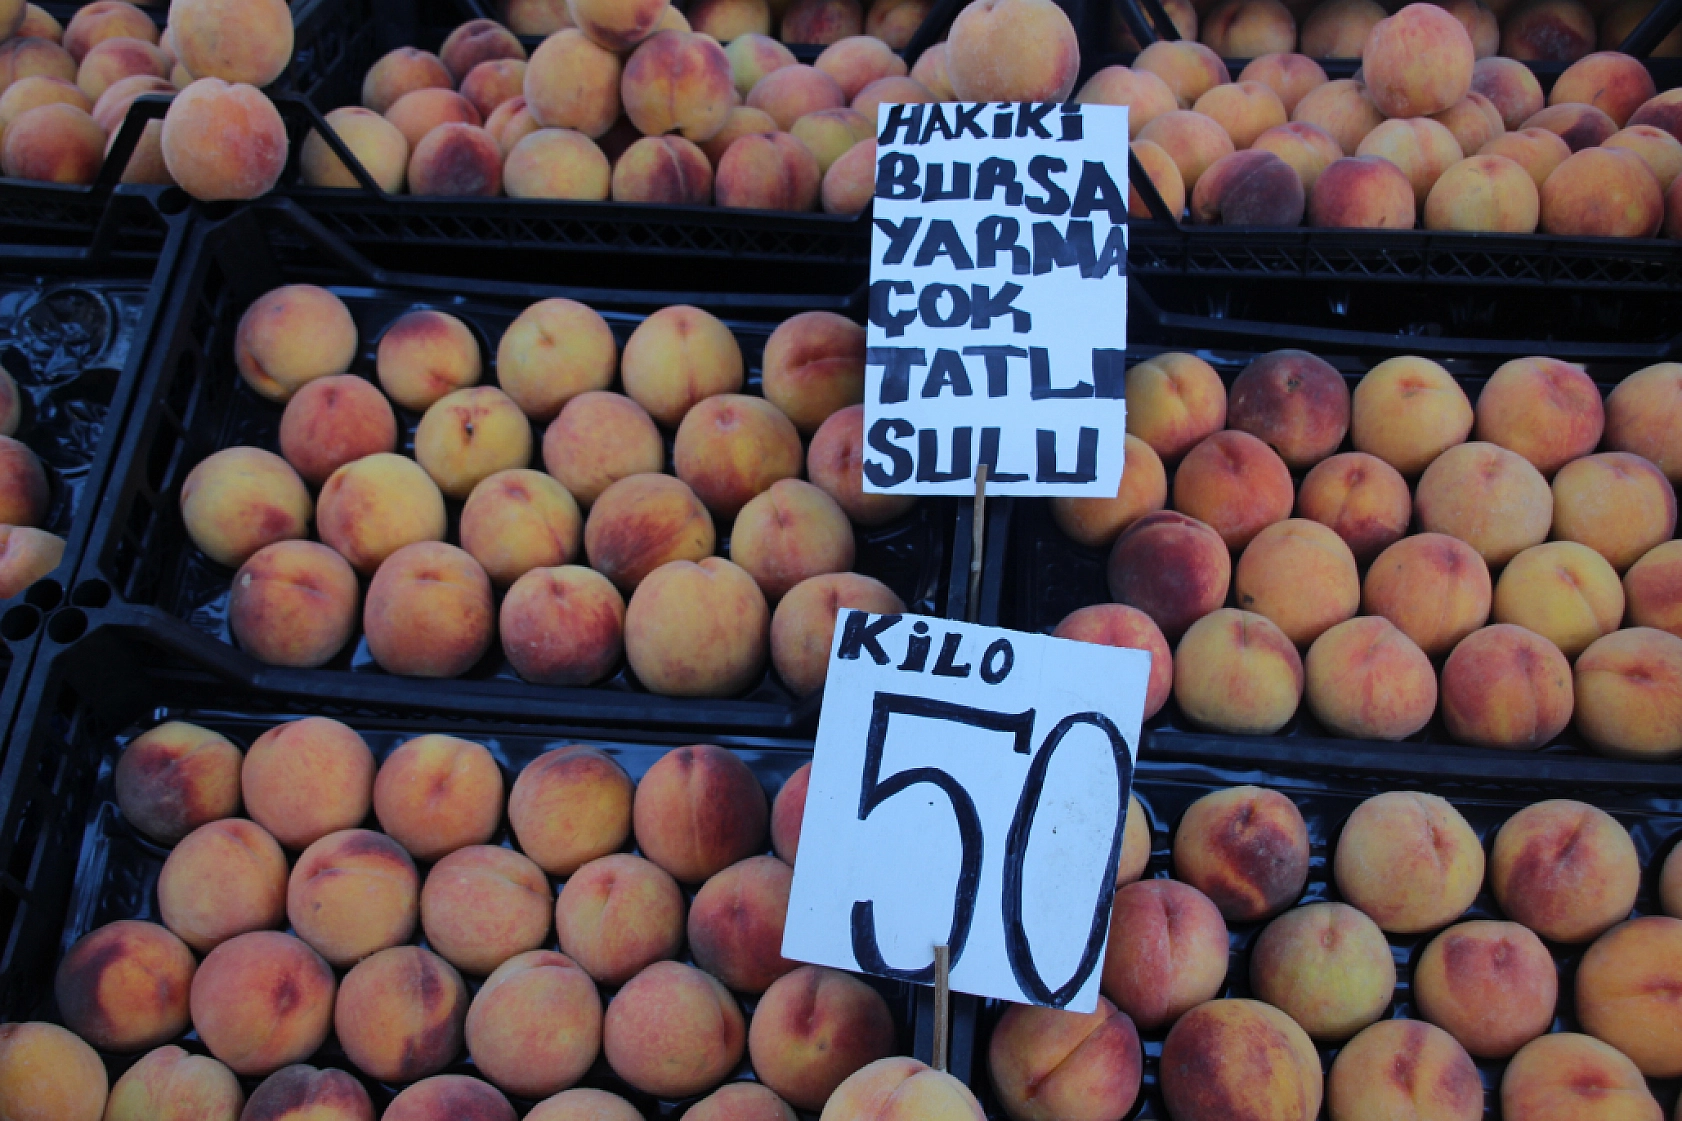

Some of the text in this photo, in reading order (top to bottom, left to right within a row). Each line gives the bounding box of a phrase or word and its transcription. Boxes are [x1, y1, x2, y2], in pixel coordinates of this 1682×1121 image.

[874, 151, 1128, 225] BURSA
[872, 215, 1129, 279] YARMA
[868, 279, 1032, 339] ÇOK
[866, 345, 1126, 405] TATLI
[863, 417, 1099, 488] SULU
[850, 691, 1133, 1011] 50
